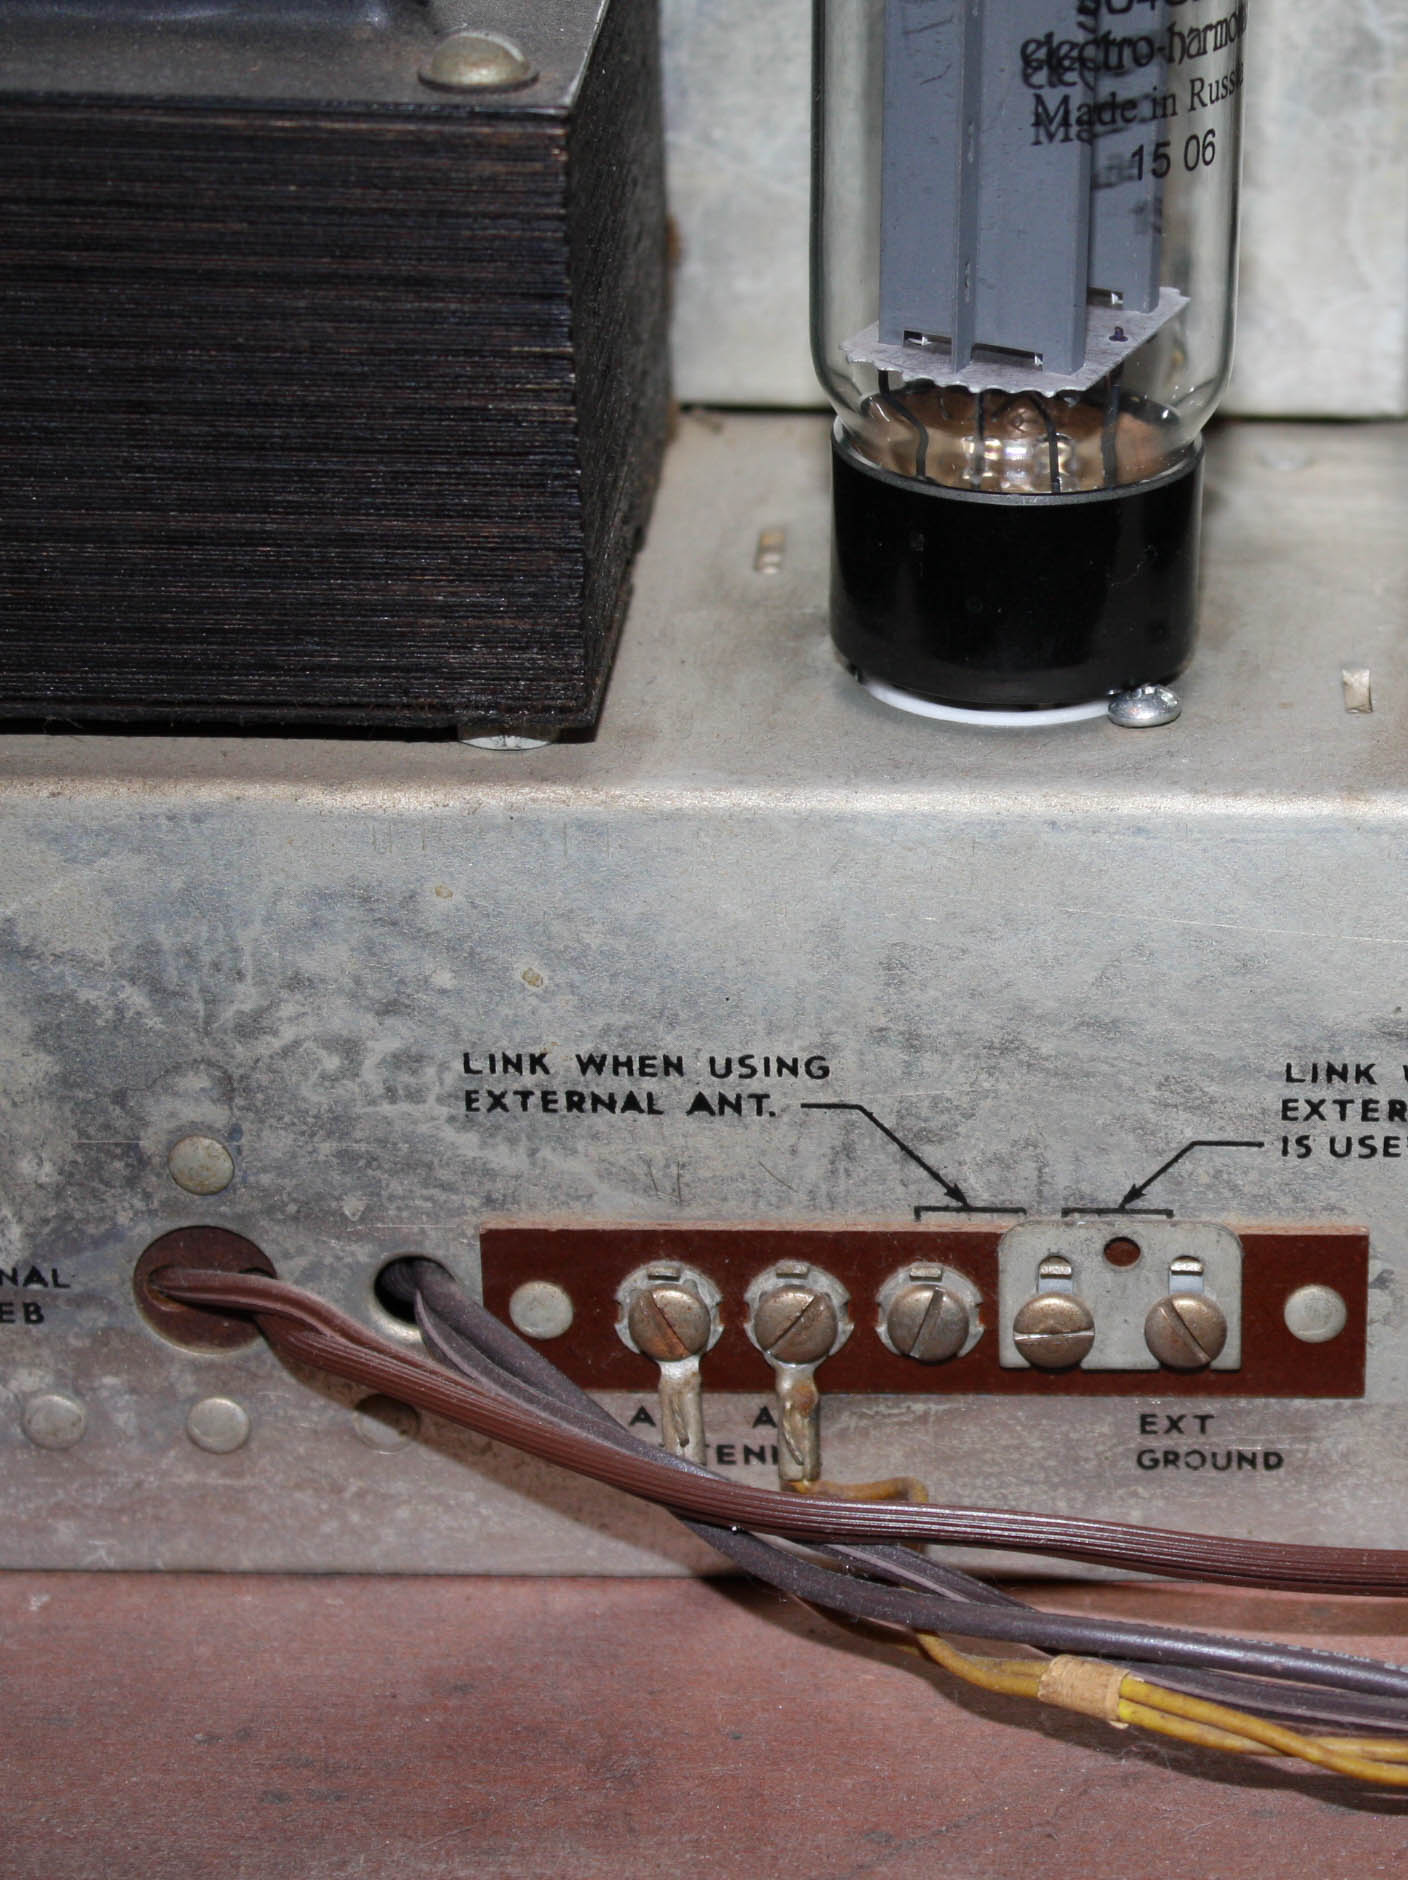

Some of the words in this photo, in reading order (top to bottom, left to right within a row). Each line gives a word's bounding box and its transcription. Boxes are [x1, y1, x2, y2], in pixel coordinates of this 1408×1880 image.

[1032, 91, 1138, 128] Made
[1150, 85, 1179, 120] in
[1130, 140, 1172, 181] 15
[1183, 128, 1216, 171] 06
[462, 1052, 551, 1076] LINK
[575, 1053, 686, 1078] WHEN
[709, 1055, 831, 1080] USING
[1284, 1061, 1378, 1086] LINK
[463, 1089, 666, 1116] EXTERNAL
[685, 1092, 778, 1118] ANT.
[1281, 1134, 1313, 1159] IS
[0, 1265, 71, 1289] NAL
[0, 1301, 45, 1324] EB
[629, 1405, 657, 1427] A
[1139, 1413, 1216, 1435] EXT
[1136, 1449, 1285, 1472] GROUND
